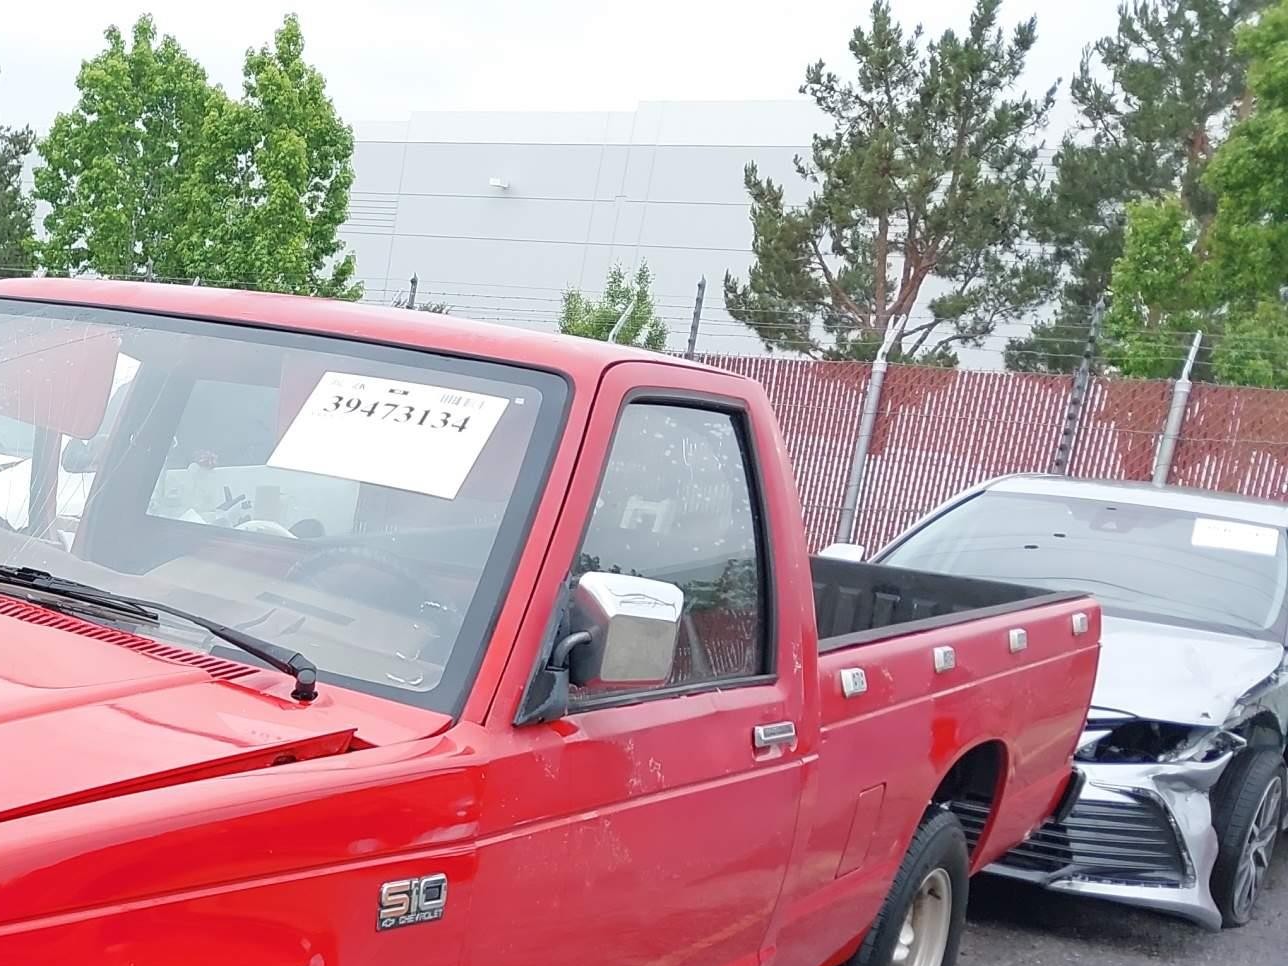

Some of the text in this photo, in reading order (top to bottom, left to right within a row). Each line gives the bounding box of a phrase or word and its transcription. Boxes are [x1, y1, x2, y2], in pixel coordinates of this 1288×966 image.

[323, 395, 471, 433] 39473134
[379, 873, 448, 919] S10
[398, 908, 444, 925] CHEVROLET
